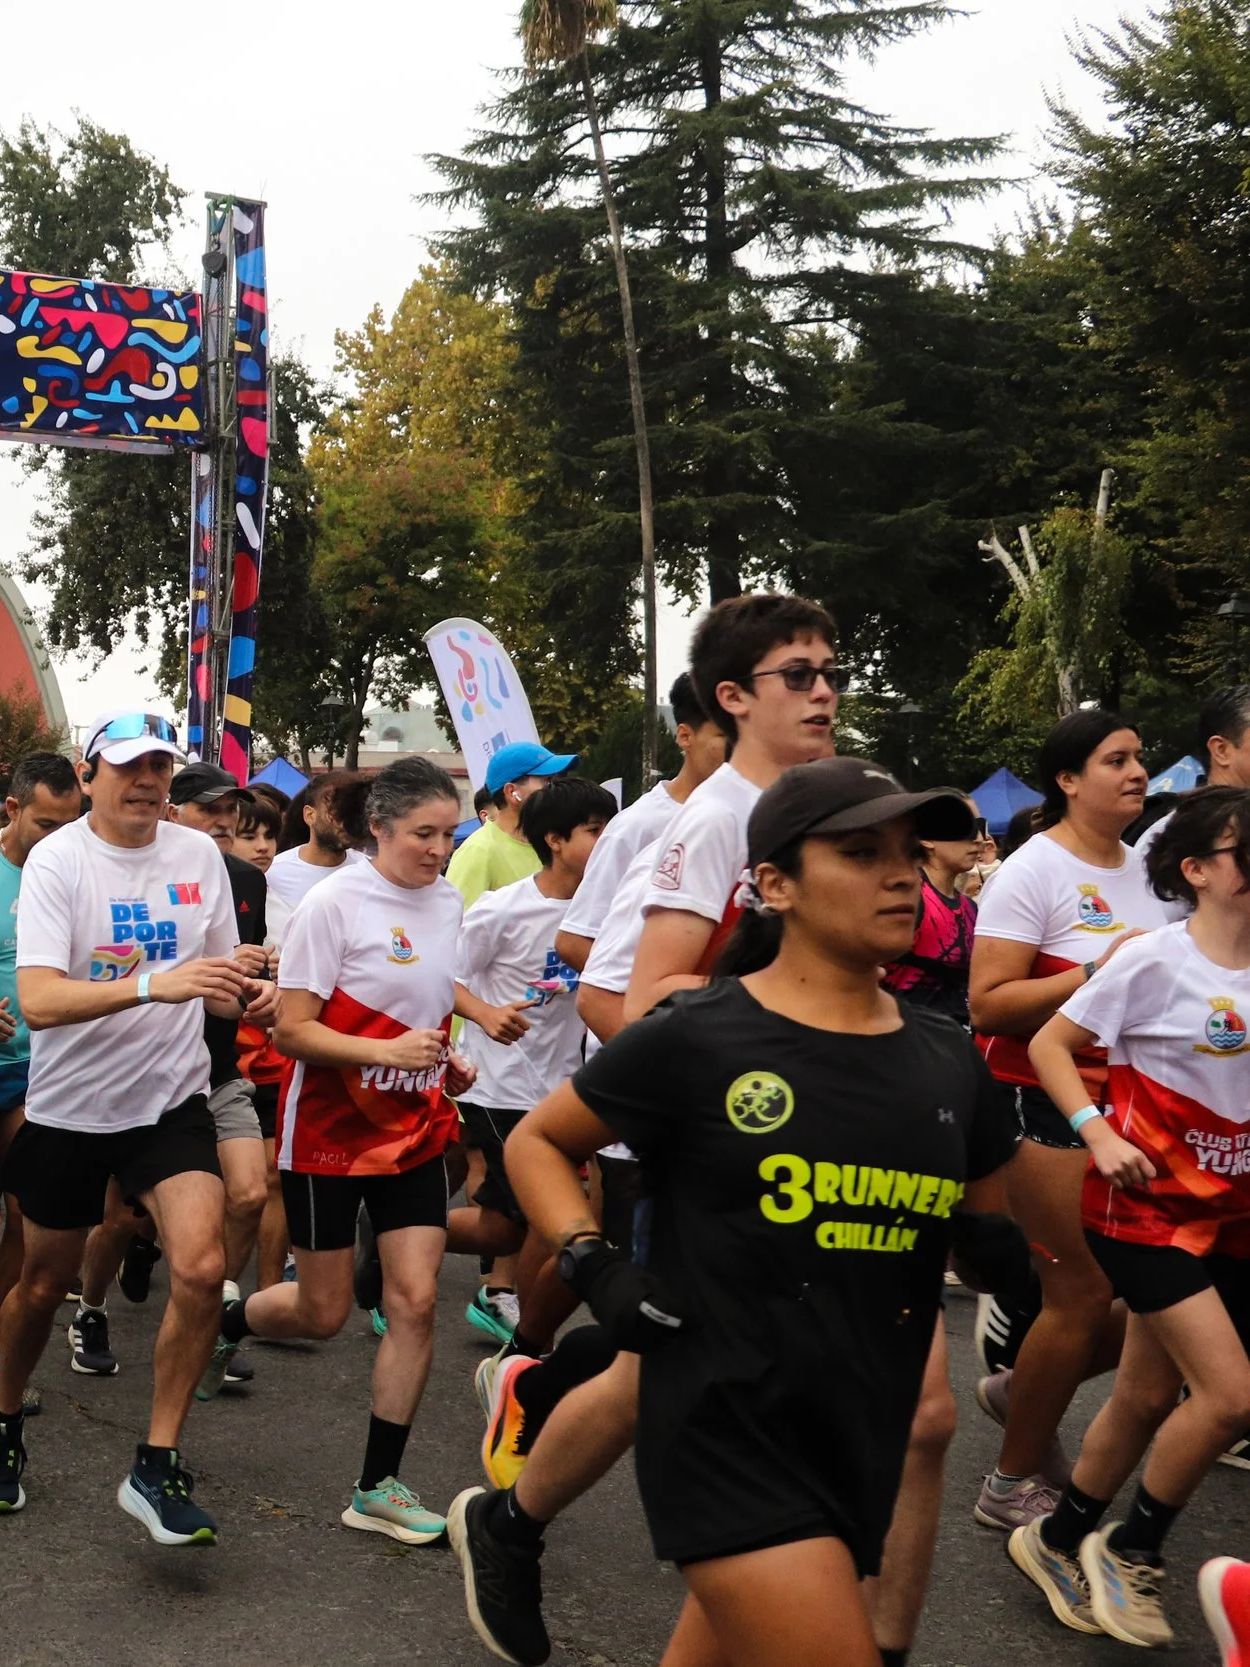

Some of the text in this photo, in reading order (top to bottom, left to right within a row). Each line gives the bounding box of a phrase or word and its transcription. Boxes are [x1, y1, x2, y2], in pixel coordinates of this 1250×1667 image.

[110, 903, 149, 923] DE
[112, 921, 177, 943] POR
[144, 941, 177, 961] TE
[1184, 1129, 1232, 1151] CLUB
[815, 1217, 918, 1252] CHILLÁN
